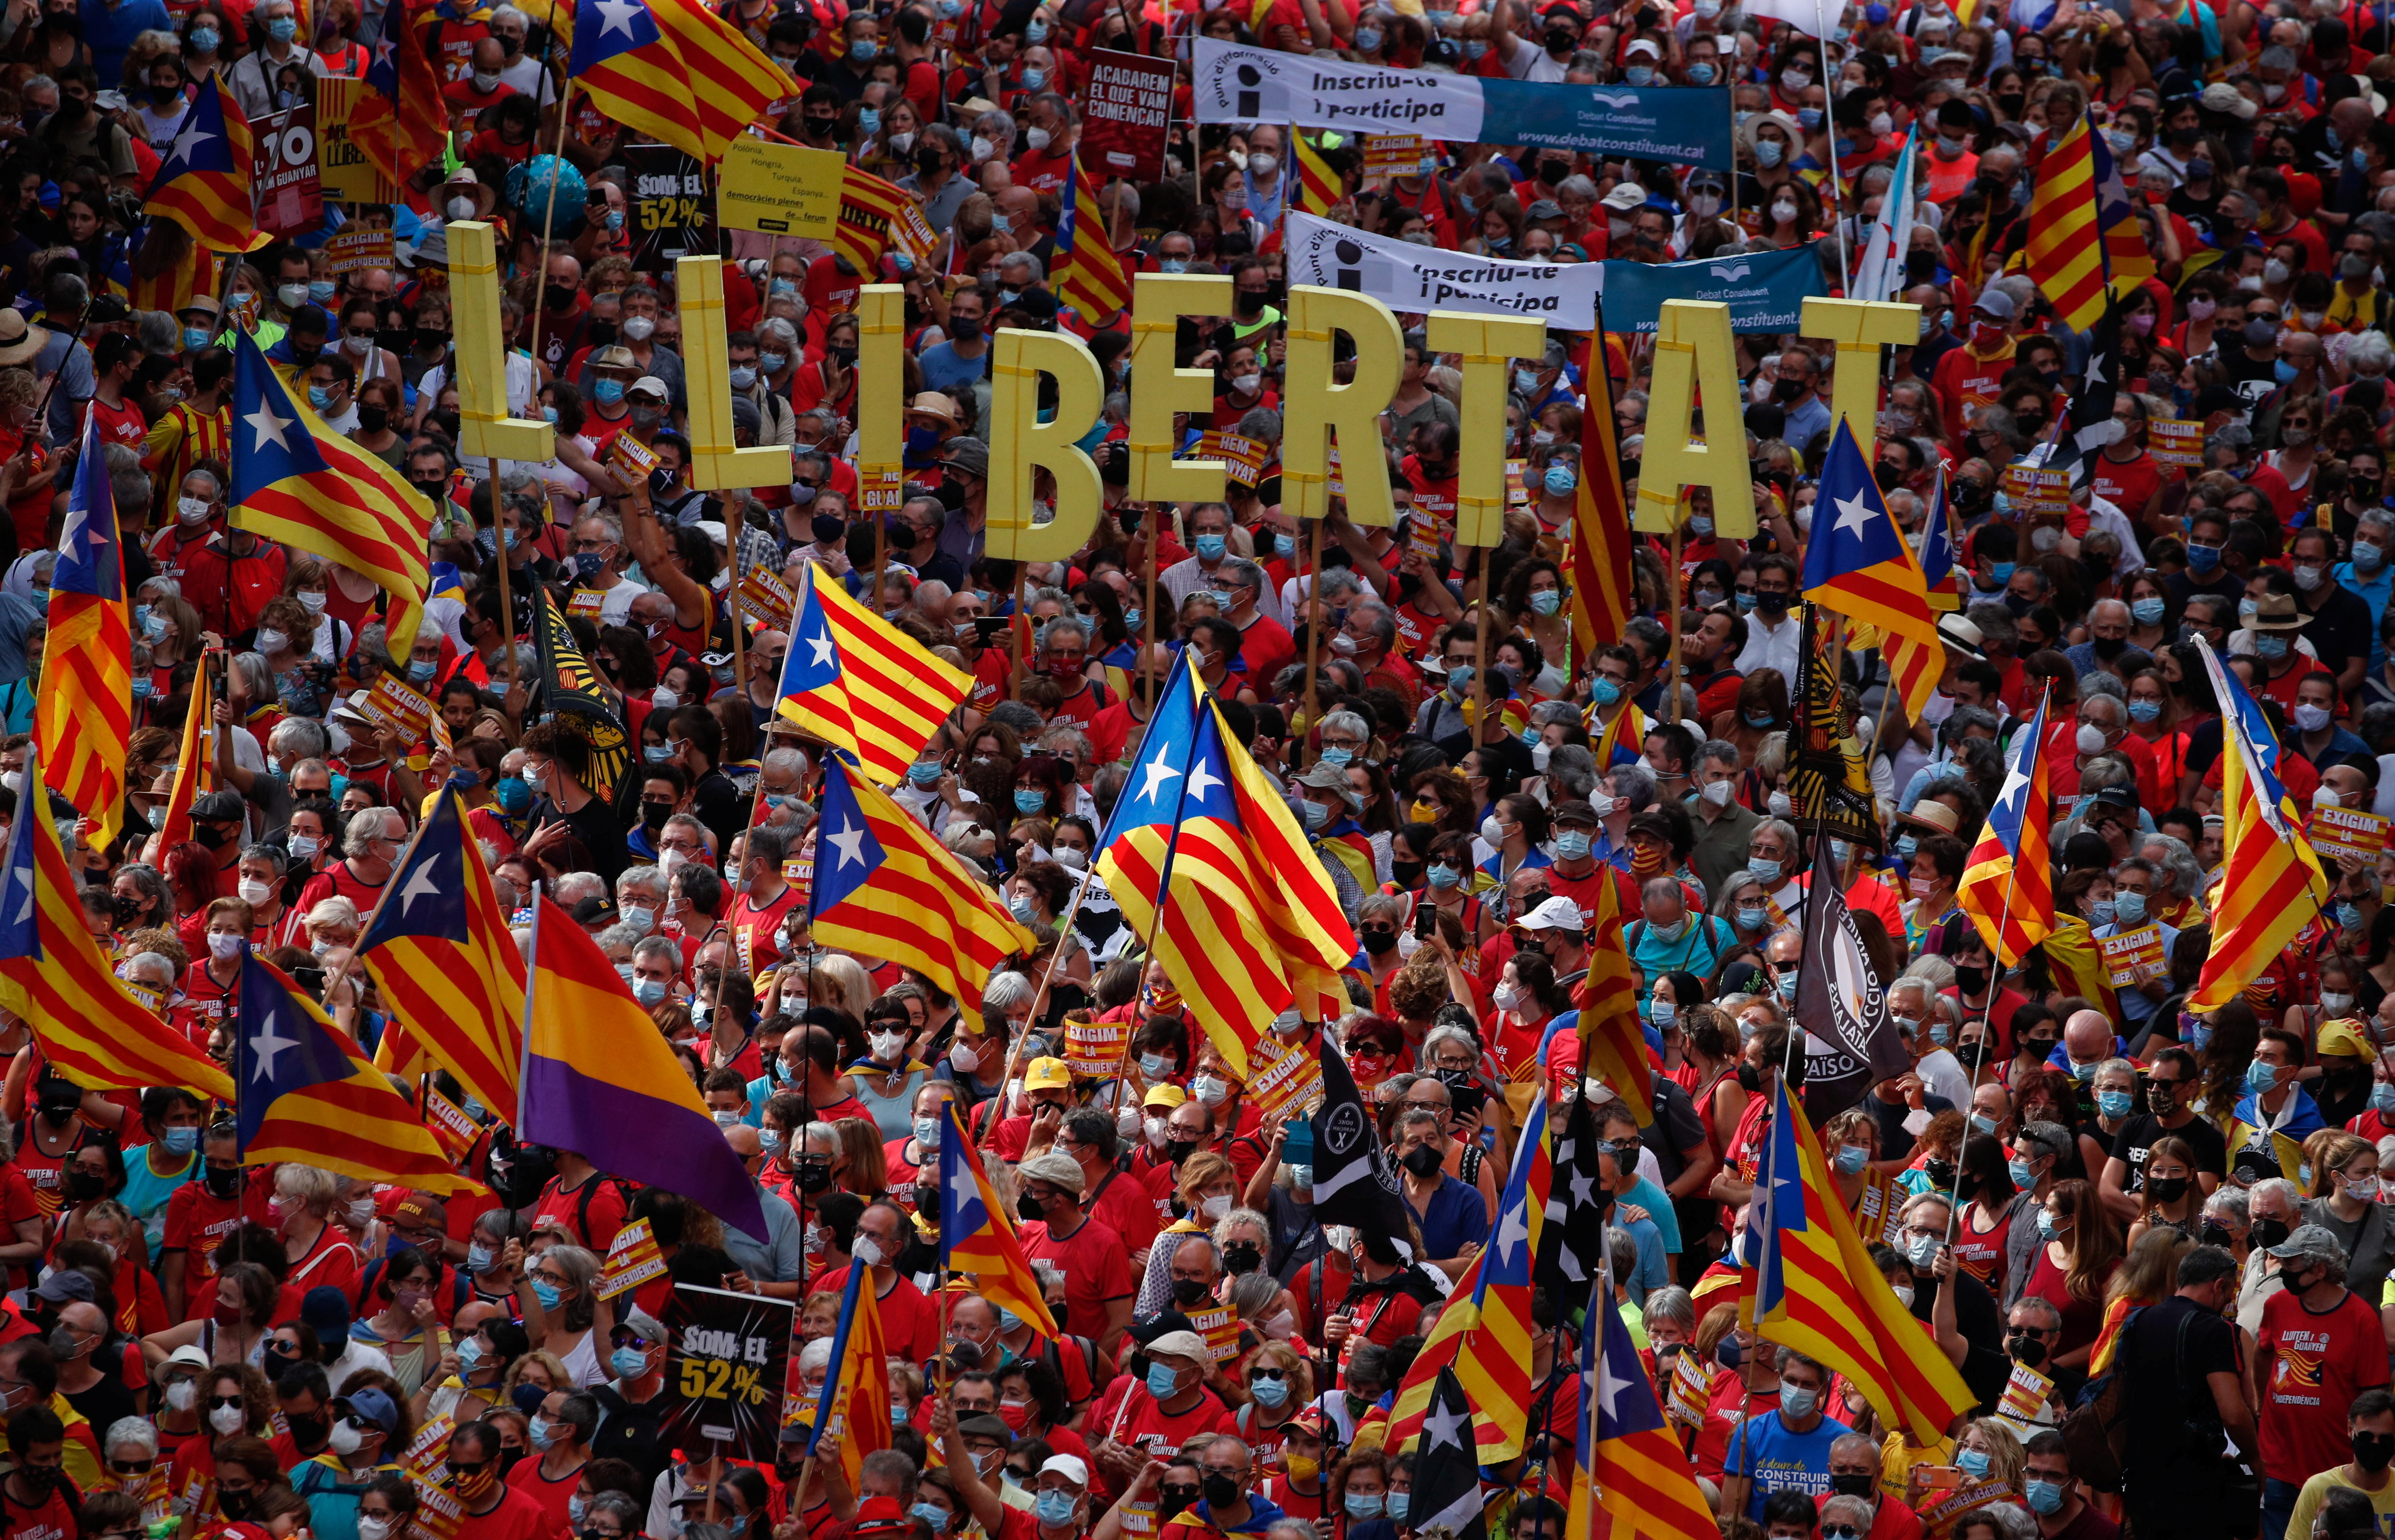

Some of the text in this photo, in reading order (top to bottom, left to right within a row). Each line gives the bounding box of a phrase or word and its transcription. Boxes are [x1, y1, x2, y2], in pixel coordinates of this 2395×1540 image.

[1093, 64, 1170, 94] ACABAREM
[1312, 72, 1439, 91] Inscriu-te
[1090, 83, 1168, 110] EL QUE VAM
[1089, 99, 1166, 128] COMENÇAR
[1327, 99, 1446, 123] participa
[1578, 109, 1604, 121] Debat
[1606, 111, 1657, 127] Constituent
[733, 143, 764, 155] Polònia,
[1372, 138, 1415, 150] EXIGIM
[1517, 132, 1706, 159] www.debatconstituent.cat
[751, 159, 784, 171] Hongria,
[277, 164, 316, 186] GUANYAR
[772, 172, 804, 184] Turquia,
[637, 175, 703, 196] SOM EL
[727, 190, 804, 209] democràcies plenes
[640, 198, 705, 230] 52%
[804, 213, 827, 223] ferum
[903, 205, 933, 245] EXIGIM
[337, 233, 385, 248] EXIGIM
[355, 245, 365, 254] LA
[331, 257, 391, 272] INDEPENDÈNCIA
[1696, 287, 1769, 300] Debat Constituent
[2153, 423, 2195, 438] EXIGIM
[618, 434, 654, 467] EXIGIM
[1220, 435, 1250, 455] HEM
[1414, 494, 1442, 502] LLUITEM
[754, 570, 795, 610] EXIGIM
[574, 592, 602, 607] EXIGIM
[763, 594, 773, 607] LA
[973, 683, 996, 700] UANYEM
[391, 704, 407, 719] LA
[2322, 809, 2380, 833] EXIGIM
[2340, 829, 2352, 843] LA
[2105, 930, 2155, 956] EXIGIM
[2129, 952, 2141, 964] LA
[1070, 1026, 1118, 1042] EXIGIM
[1085, 1045, 1096, 1057] LA
[1251, 1057, 1262, 1069] LA
[1256, 1050, 1305, 1094] EXIGIM
[1284, 1081, 1297, 1093] LA
[427, 1092, 473, 1137] EXIGIM
[1861, 1184, 1881, 1220] HEM
[1953, 1243, 1983, 1255] LLUITEM
[1966, 1250, 1997, 1261] GUANYEM
[617, 1252, 631, 1268] LA
[2281, 1330, 2311, 1342] LLUITEM
[684, 1326, 768, 1366] SOM EL
[2293, 1340, 2327, 1353] GUANYEM
[679, 1358, 767, 1405] 52%
[1676, 1356, 1707, 1394] EXIGIM
[1678, 1381, 1686, 1397] LA
[2275, 1394, 2320, 1406] INDEPENDÈNCIA
[1148, 1444, 1179, 1457] GUANYEM
[424, 1452, 435, 1466] LA
[1757, 1457, 1807, 1472] el deure de
[1755, 1470, 1830, 1483] CONSTRUIR
[419, 1508, 433, 1524] LA
